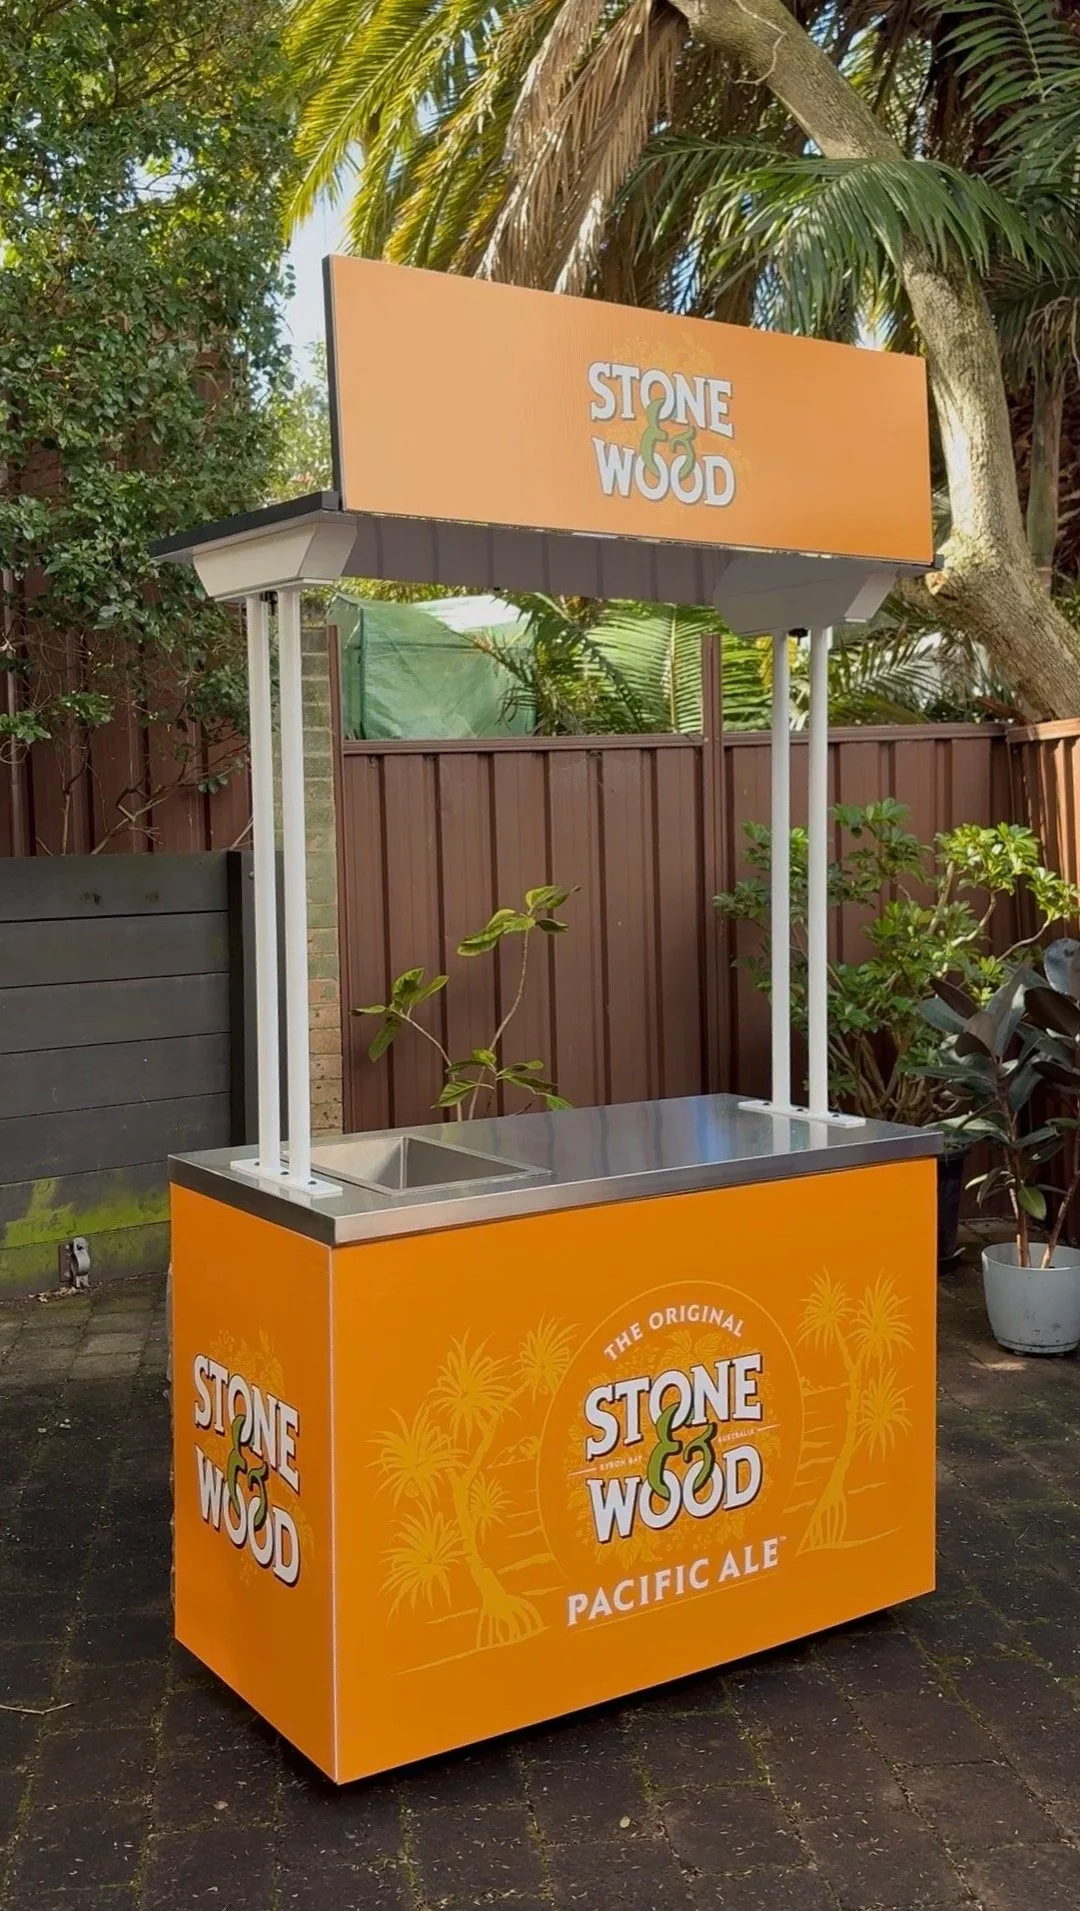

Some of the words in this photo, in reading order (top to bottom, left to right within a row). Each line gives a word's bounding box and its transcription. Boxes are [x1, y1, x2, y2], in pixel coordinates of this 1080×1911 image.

[588, 361, 734, 439] STONE
[591, 436, 736, 507] WOOD
[603, 1321, 643, 1361] THE
[648, 1303, 744, 1337] ORIGINAL
[193, 1354, 300, 1495] STONE
[584, 1353, 763, 1461] STONE
[600, 1458, 626, 1471] BYRON
[628, 1454, 643, 1465] BAY
[717, 1428, 755, 1443] AUSTRALIA
[195, 1443, 300, 1587] WOOD
[585, 1444, 763, 1544] WOOD
[566, 1557, 709, 1626] PACIFIC
[717, 1537, 779, 1583] ALE
